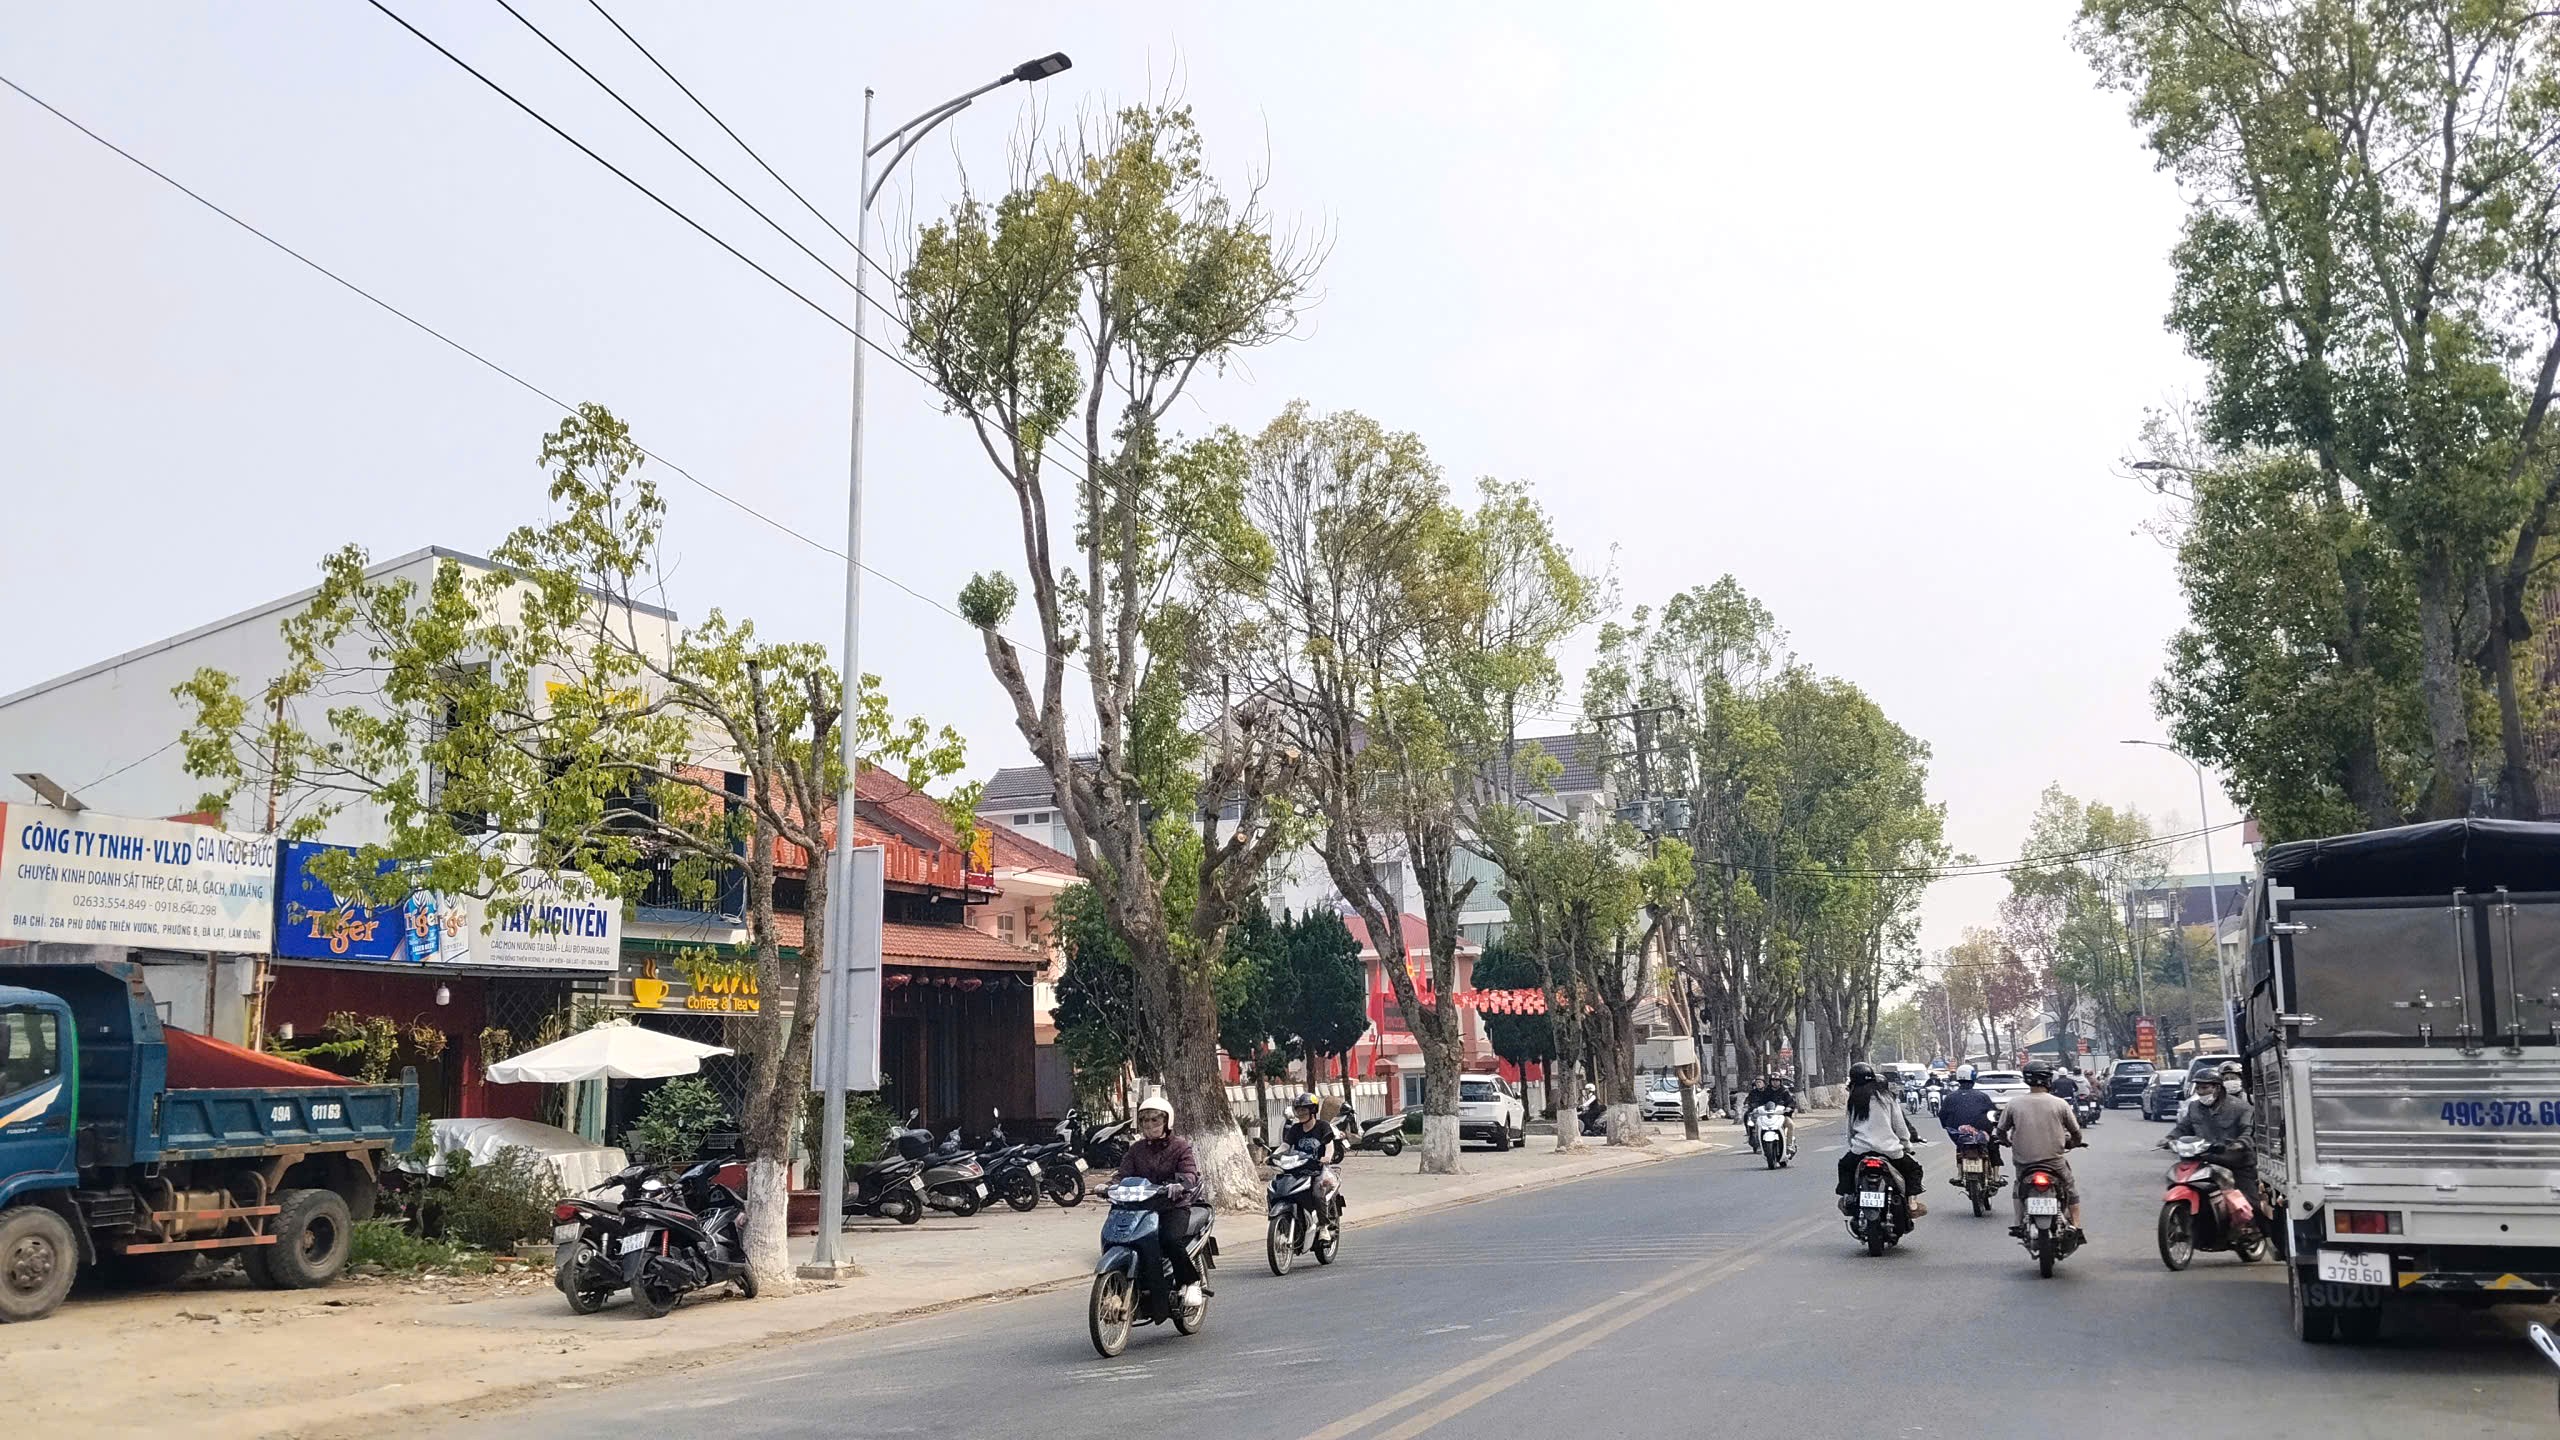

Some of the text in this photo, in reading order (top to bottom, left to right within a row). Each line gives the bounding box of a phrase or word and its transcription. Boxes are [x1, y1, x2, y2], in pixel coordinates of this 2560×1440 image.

[21, 820, 70, 854] CÔNG
[74, 830, 96, 856] TY
[98, 833, 144, 861] TNHH
[153, 839, 192, 866] VLXD
[196, 837, 215, 862] GIA
[18, 863, 59, 881] CHUYÊN
[61, 867, 86, 884] KINH
[87, 870, 121, 887] DOANH
[229, 882, 238, 896] XI
[73, 895, 147, 911] 02633.554.849
[154, 900, 217, 916] 0918.640.298
[13, 914, 27, 928] ĐỊA
[49, 917, 65, 929] 26A
[539, 901, 608, 938] NGUYÊN
[687, 995, 749, 1011] Coffee & Tea
[270, 1106, 291, 1122] 49A
[2340, 1252, 2369, 1267] 49C
[2327, 1266, 2383, 1283] 378.60
[2302, 1283, 2380, 1308] ISUZU
